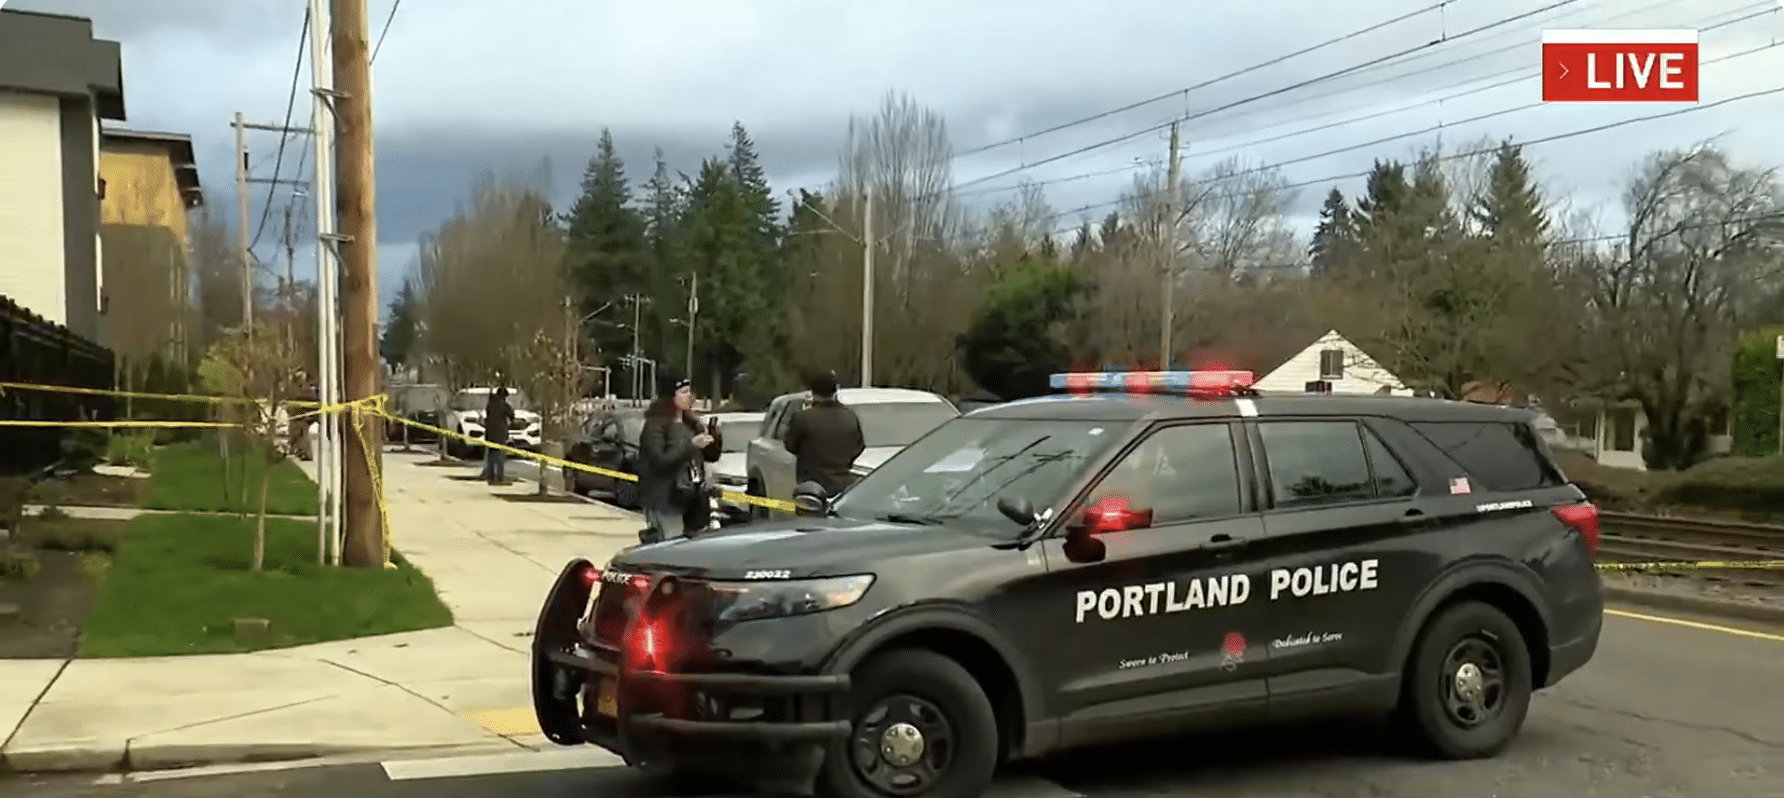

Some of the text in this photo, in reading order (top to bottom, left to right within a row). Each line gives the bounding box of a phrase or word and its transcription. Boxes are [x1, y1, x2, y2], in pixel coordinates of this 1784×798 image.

[601, 571, 631, 585] POLICE
[1075, 559, 1379, 623] PORTLAND POLICE
